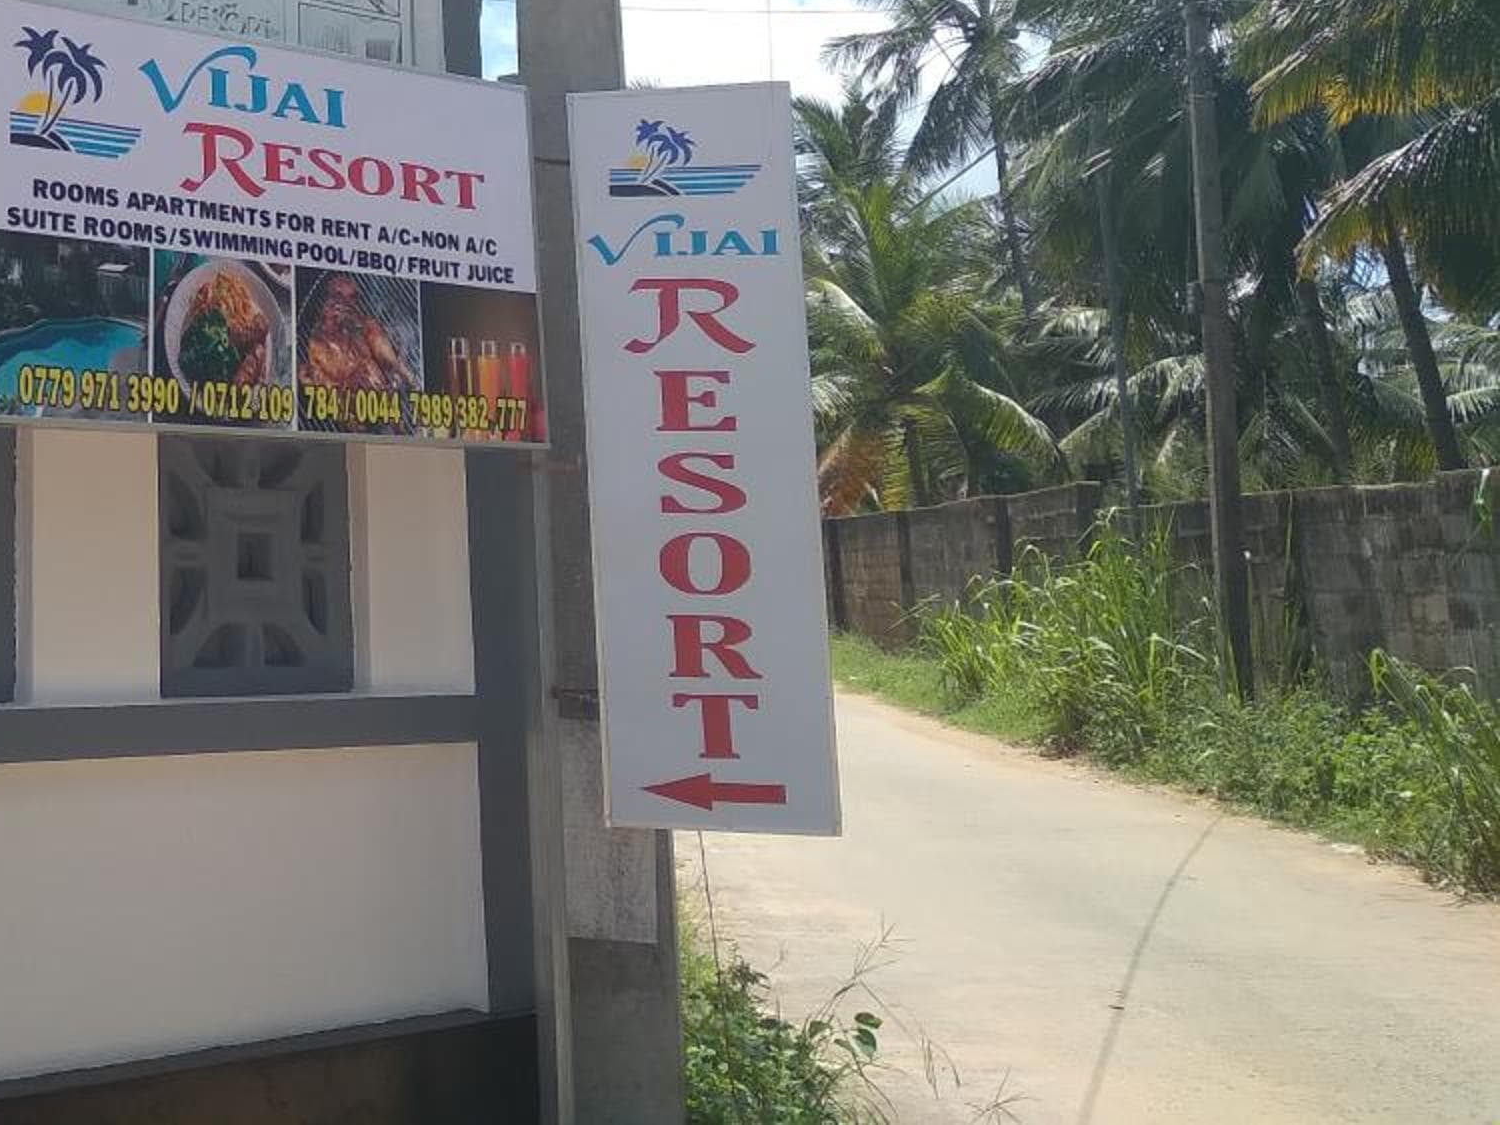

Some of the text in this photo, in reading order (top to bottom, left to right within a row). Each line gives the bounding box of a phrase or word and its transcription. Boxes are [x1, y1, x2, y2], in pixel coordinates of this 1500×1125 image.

[138, 46, 347, 129] VIJAI
[179, 122, 486, 210] RESORT
[7, 207, 76, 233] SUITE
[467, 265, 515, 284] JUICE
[33, 179, 119, 207] ROOMS
[127, 192, 271, 227] APARTMENTS
[276, 212, 316, 233] FOR
[321, 219, 371, 241] RENT
[465, 237, 498, 256] A/C
[587, 214, 781, 266] VIJAI
[19, 365, 76, 408] 0779
[81, 371, 120, 411] 971
[127, 374, 180, 415] 3990
[202, 381, 252, 420] 0712
[258, 385, 294, 423] 109
[303, 386, 338, 422] 784
[355, 389, 400, 425] 0044
[409, 391, 452, 428] 7989
[456, 395, 489, 430] 382
[496, 397, 528, 431] 777
[622, 277, 764, 760] RESORT
